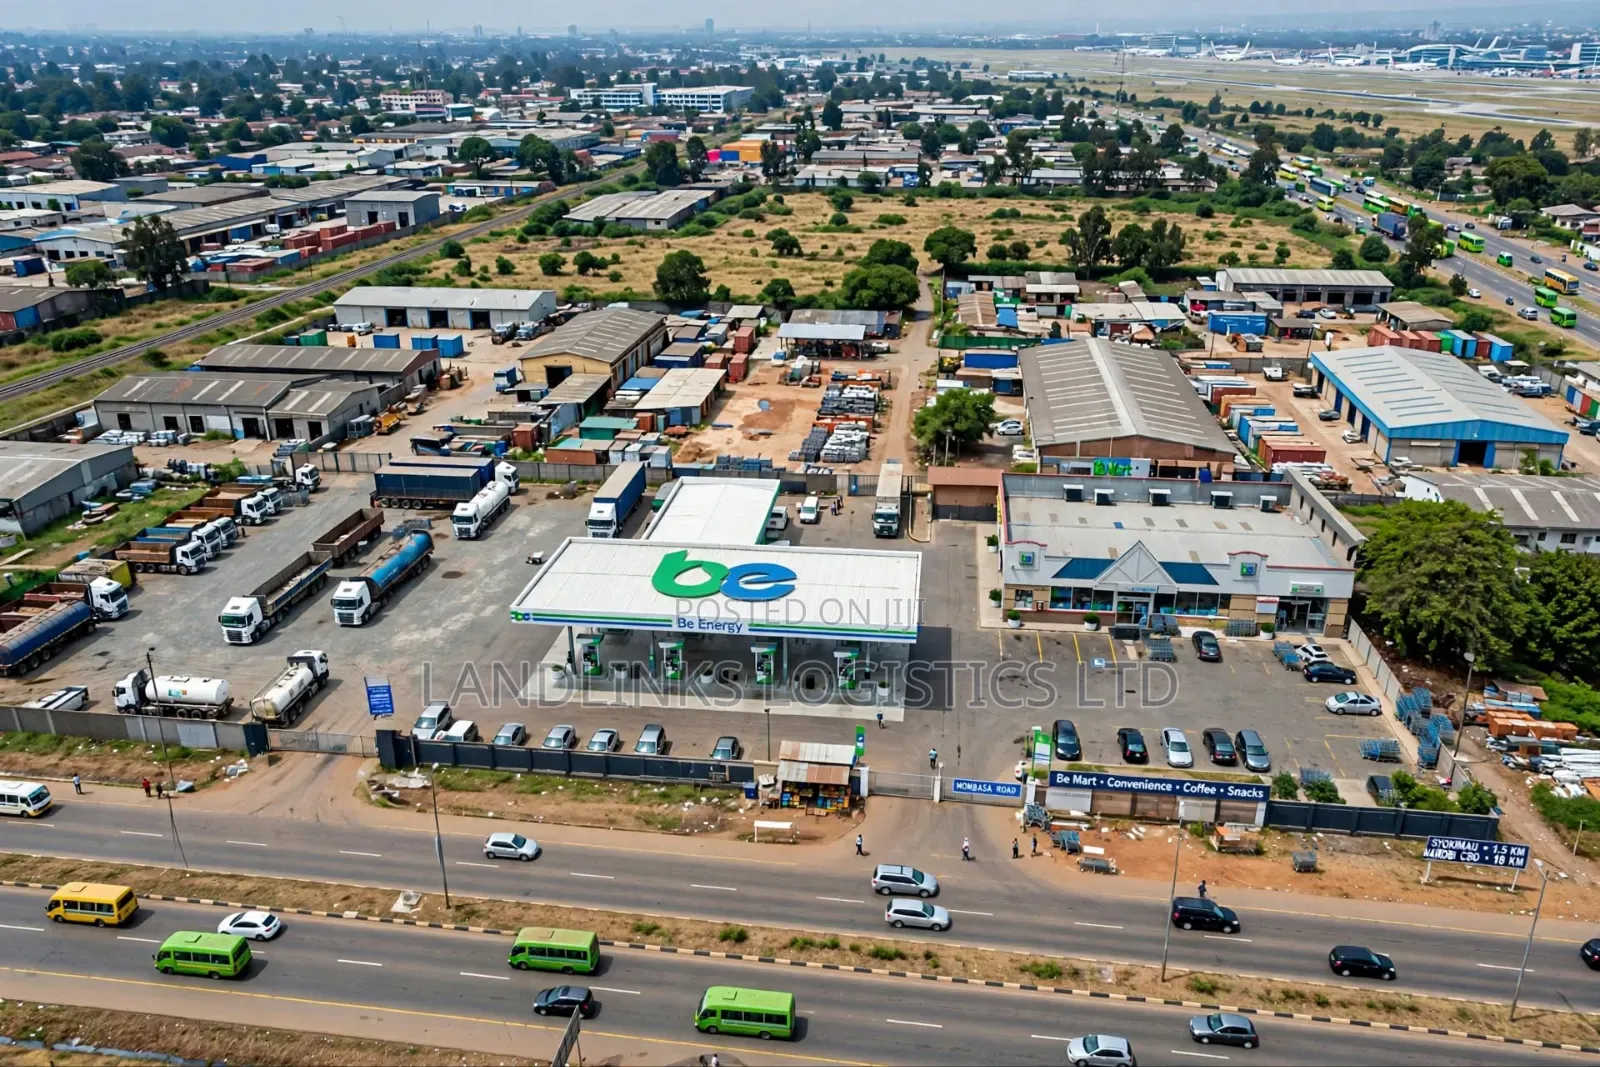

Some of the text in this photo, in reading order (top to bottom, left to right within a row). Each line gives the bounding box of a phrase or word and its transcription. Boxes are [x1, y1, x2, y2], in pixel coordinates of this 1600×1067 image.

[677, 617, 743, 633] Be Energy
[996, 785, 1017, 794] ROAD
[1056, 773, 1264, 799] Be Mart Convenience Coffee Snacks
[1493, 845, 1508, 854] 1.5
[1510, 846, 1526, 857] KM
[1508, 856, 1525, 867] KM
